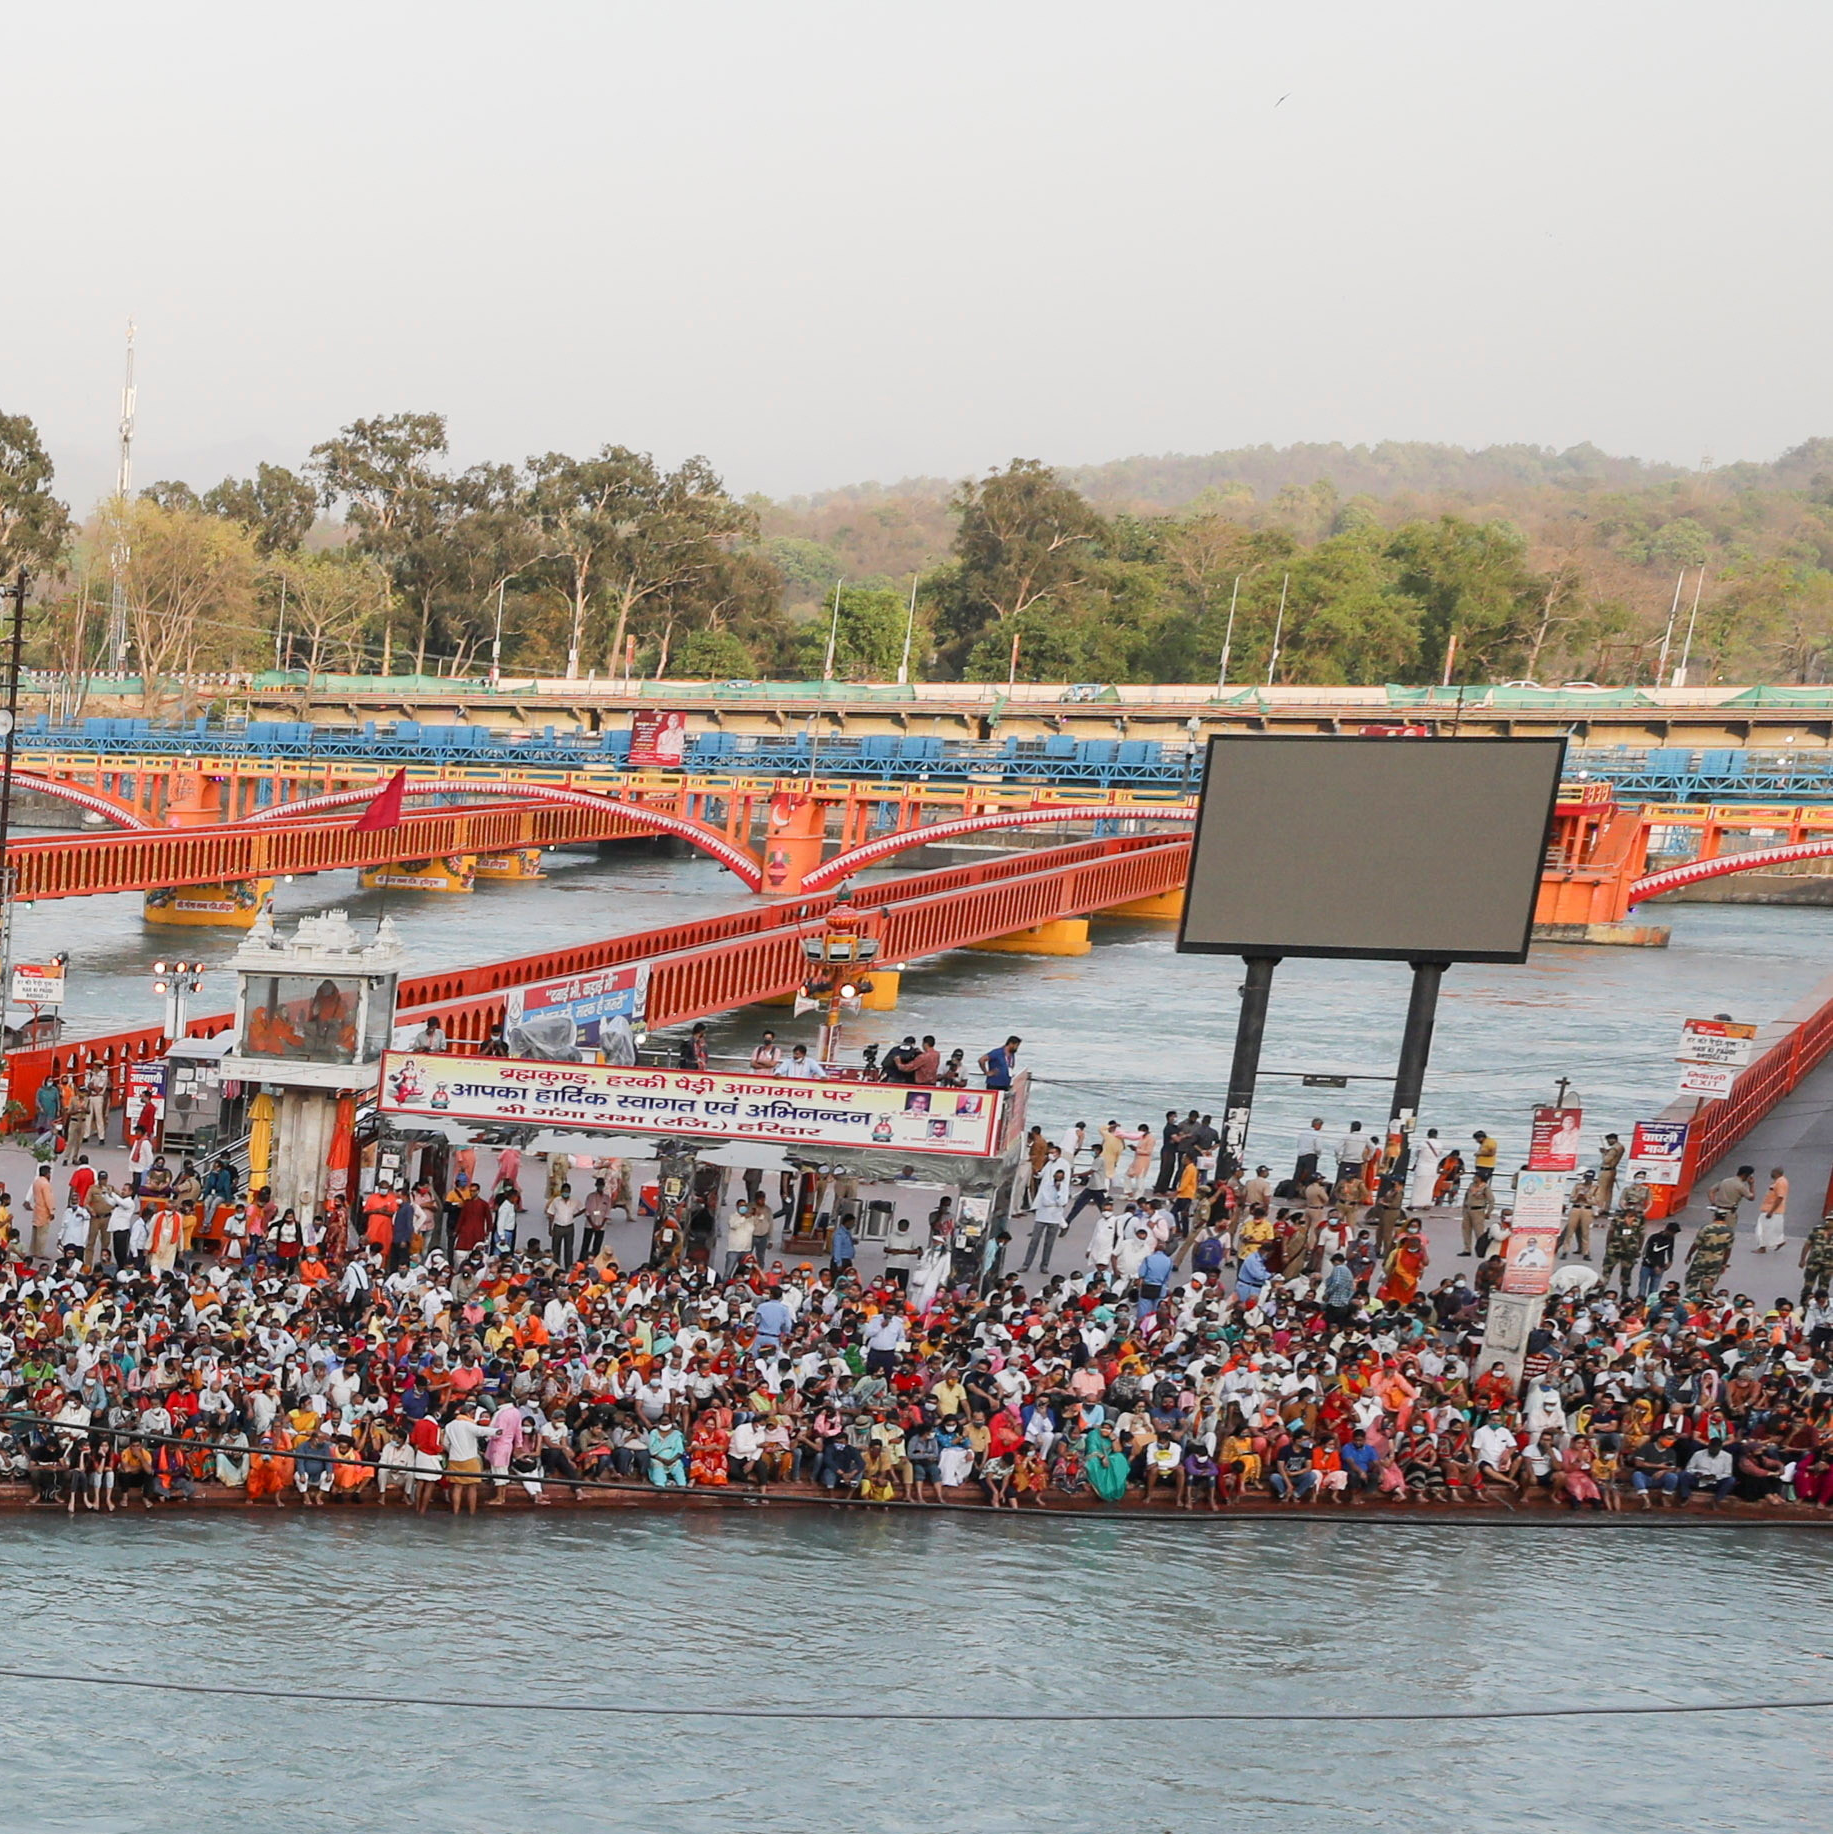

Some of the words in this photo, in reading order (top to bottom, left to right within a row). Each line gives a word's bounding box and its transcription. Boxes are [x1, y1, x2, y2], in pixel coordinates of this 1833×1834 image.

[499, 1067, 596, 1088] ब्रह्मकुण्ड,
[607, 1074, 668, 1091] हरकी
[722, 1082, 814, 1099] आगमन
[821, 1090, 855, 1103] पर
[1690, 1079, 1720, 1087] EXIT
[451, 1082, 527, 1101] आपका
[535, 1085, 608, 1106] हार्दिक
[616, 1093, 699, 1113] स्वागत
[704, 1096, 739, 1116] एवं
[745, 1099, 873, 1127] अभिनन्दन
[497, 1104, 525, 1115] श्री
[532, 1107, 587, 1119] गंगा
[593, 1112, 645, 1124] सभा
[737, 1122, 823, 1137] हरिद्वार
[1642, 1131, 1678, 1143] वापसी
[1644, 1143, 1669, 1155] मार्ग
